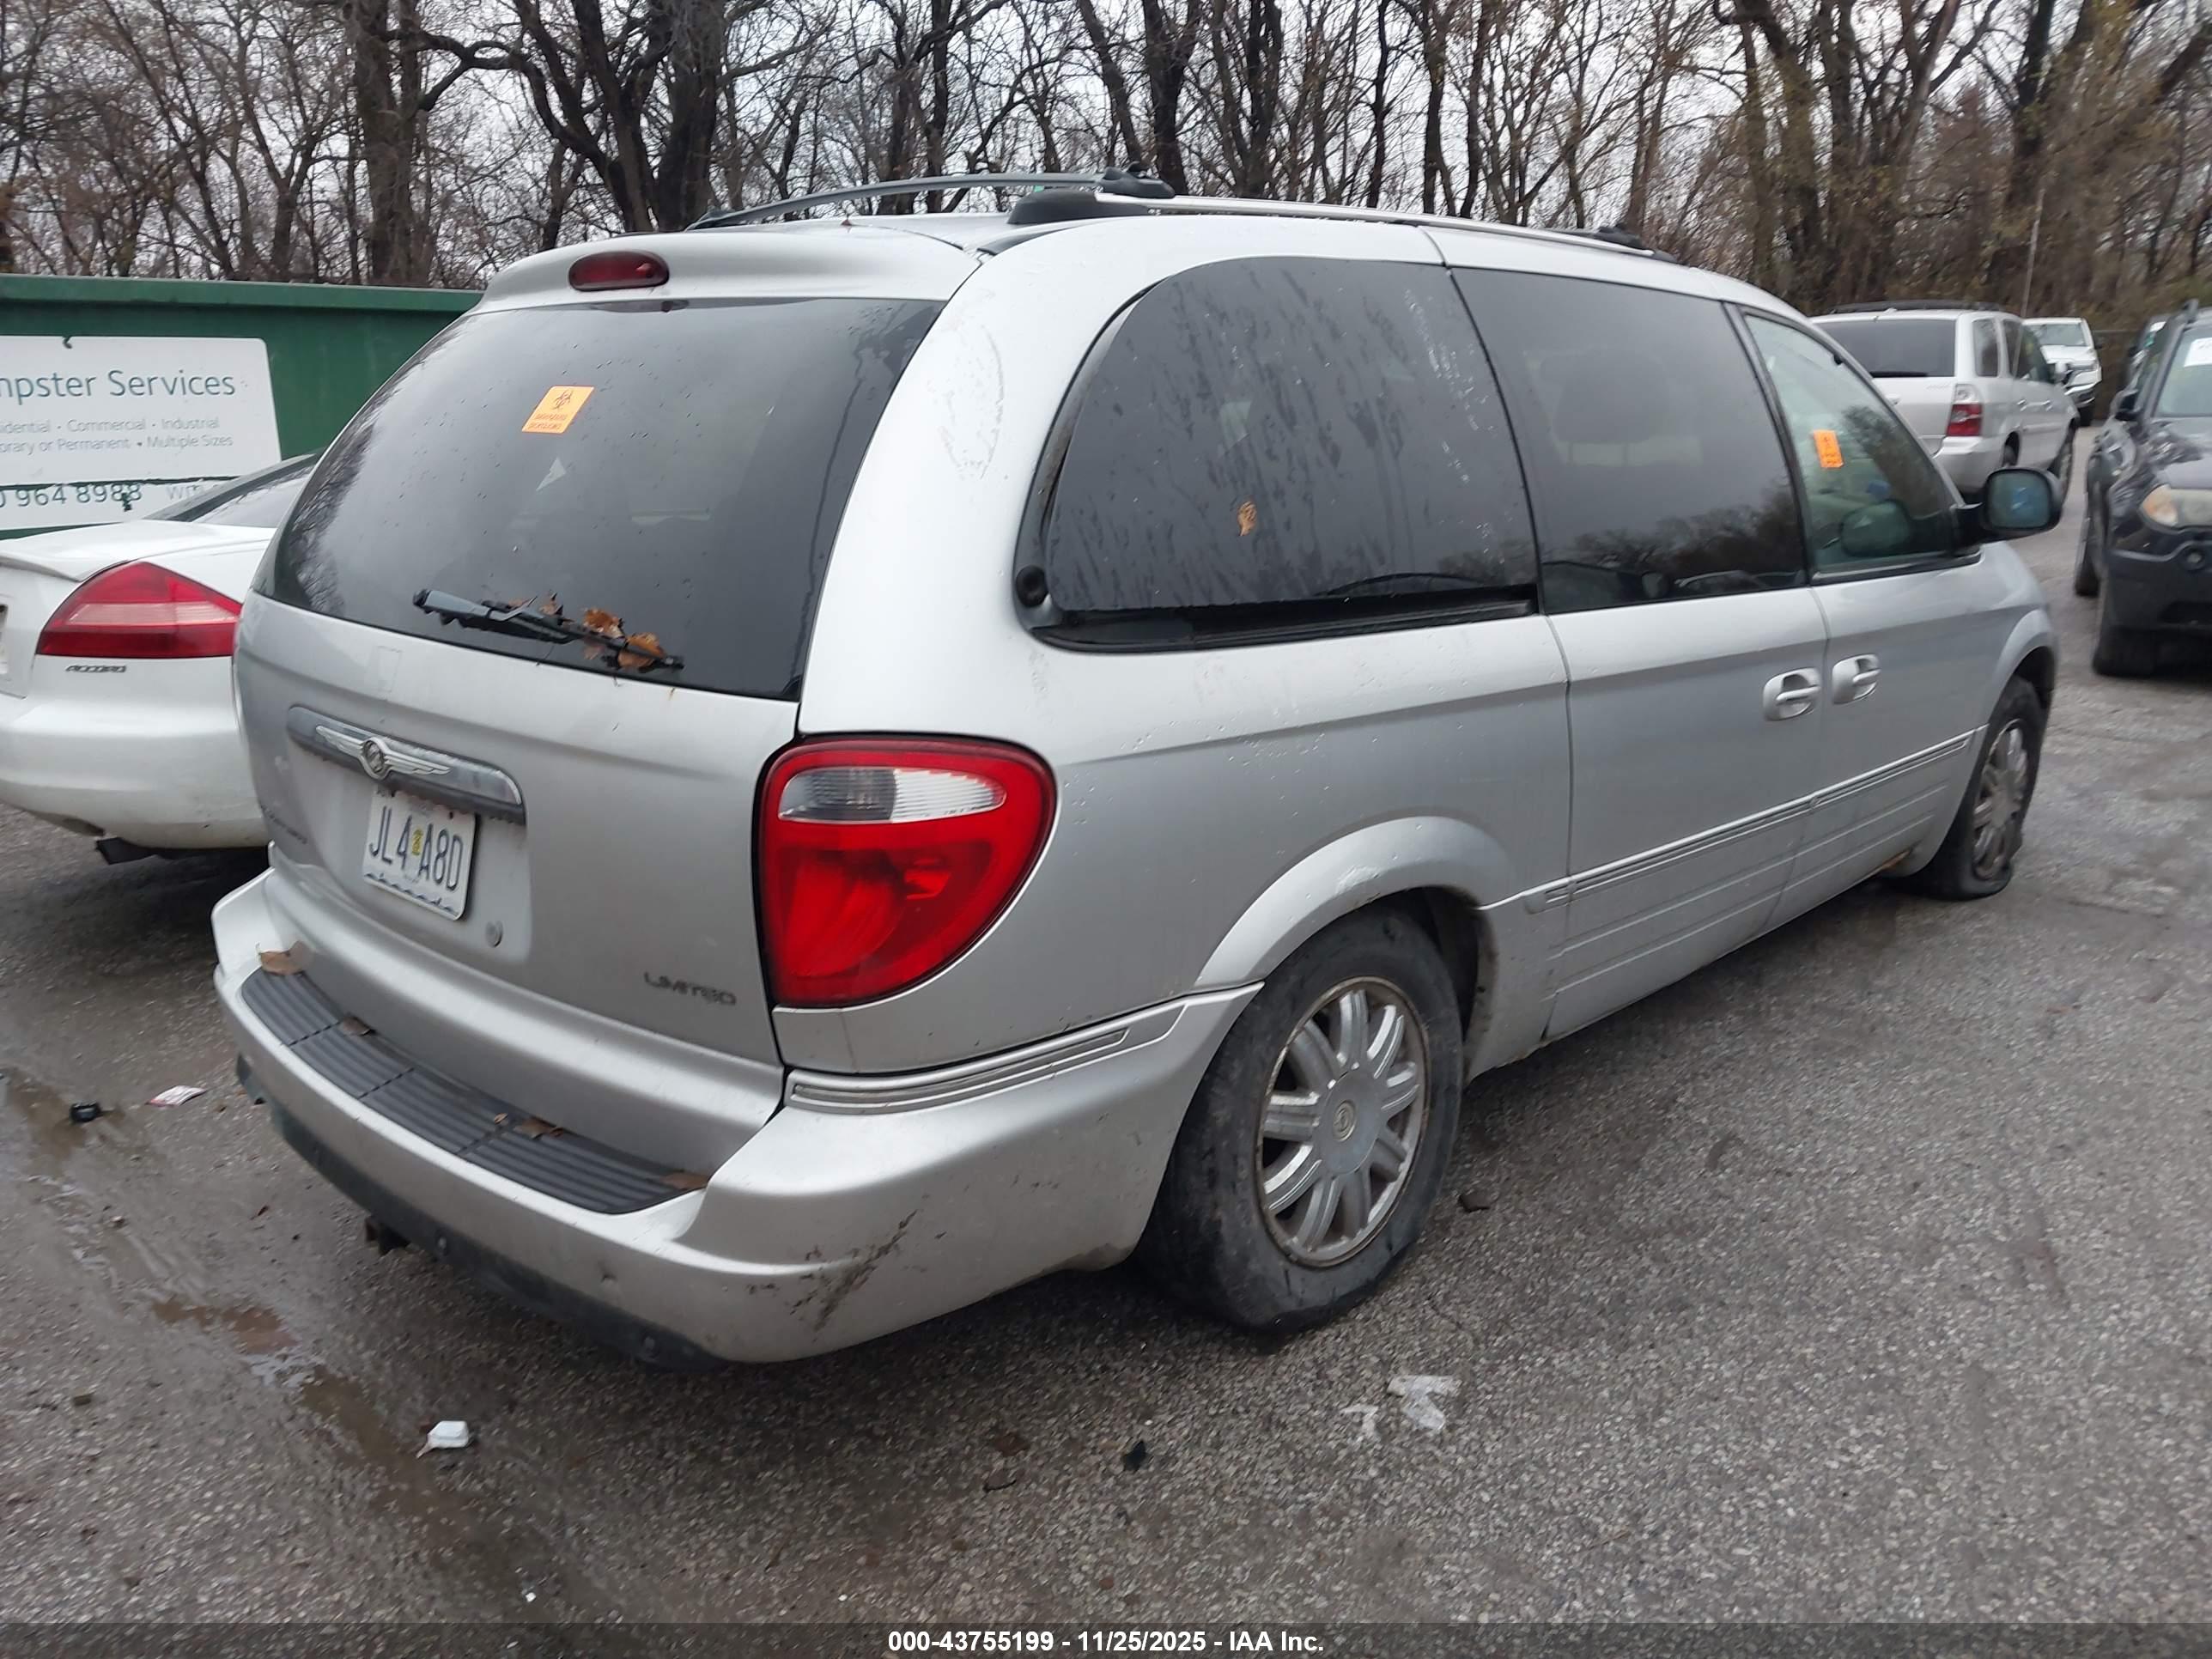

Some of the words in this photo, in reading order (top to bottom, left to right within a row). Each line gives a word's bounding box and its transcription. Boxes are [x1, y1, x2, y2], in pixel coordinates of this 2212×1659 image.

[107, 370, 235, 396] Services
[67, 419, 145, 432] Commercial
[161, 417, 219, 430] Industrial
[39, 442, 53, 453] or
[58, 438, 130, 452] Permanent
[147, 435, 198, 450] Multiple
[200, 434, 233, 447] Sizes
[15, 484, 66, 507] 964
[76, 482, 143, 504] 8988
[368, 805, 413, 870] JL4
